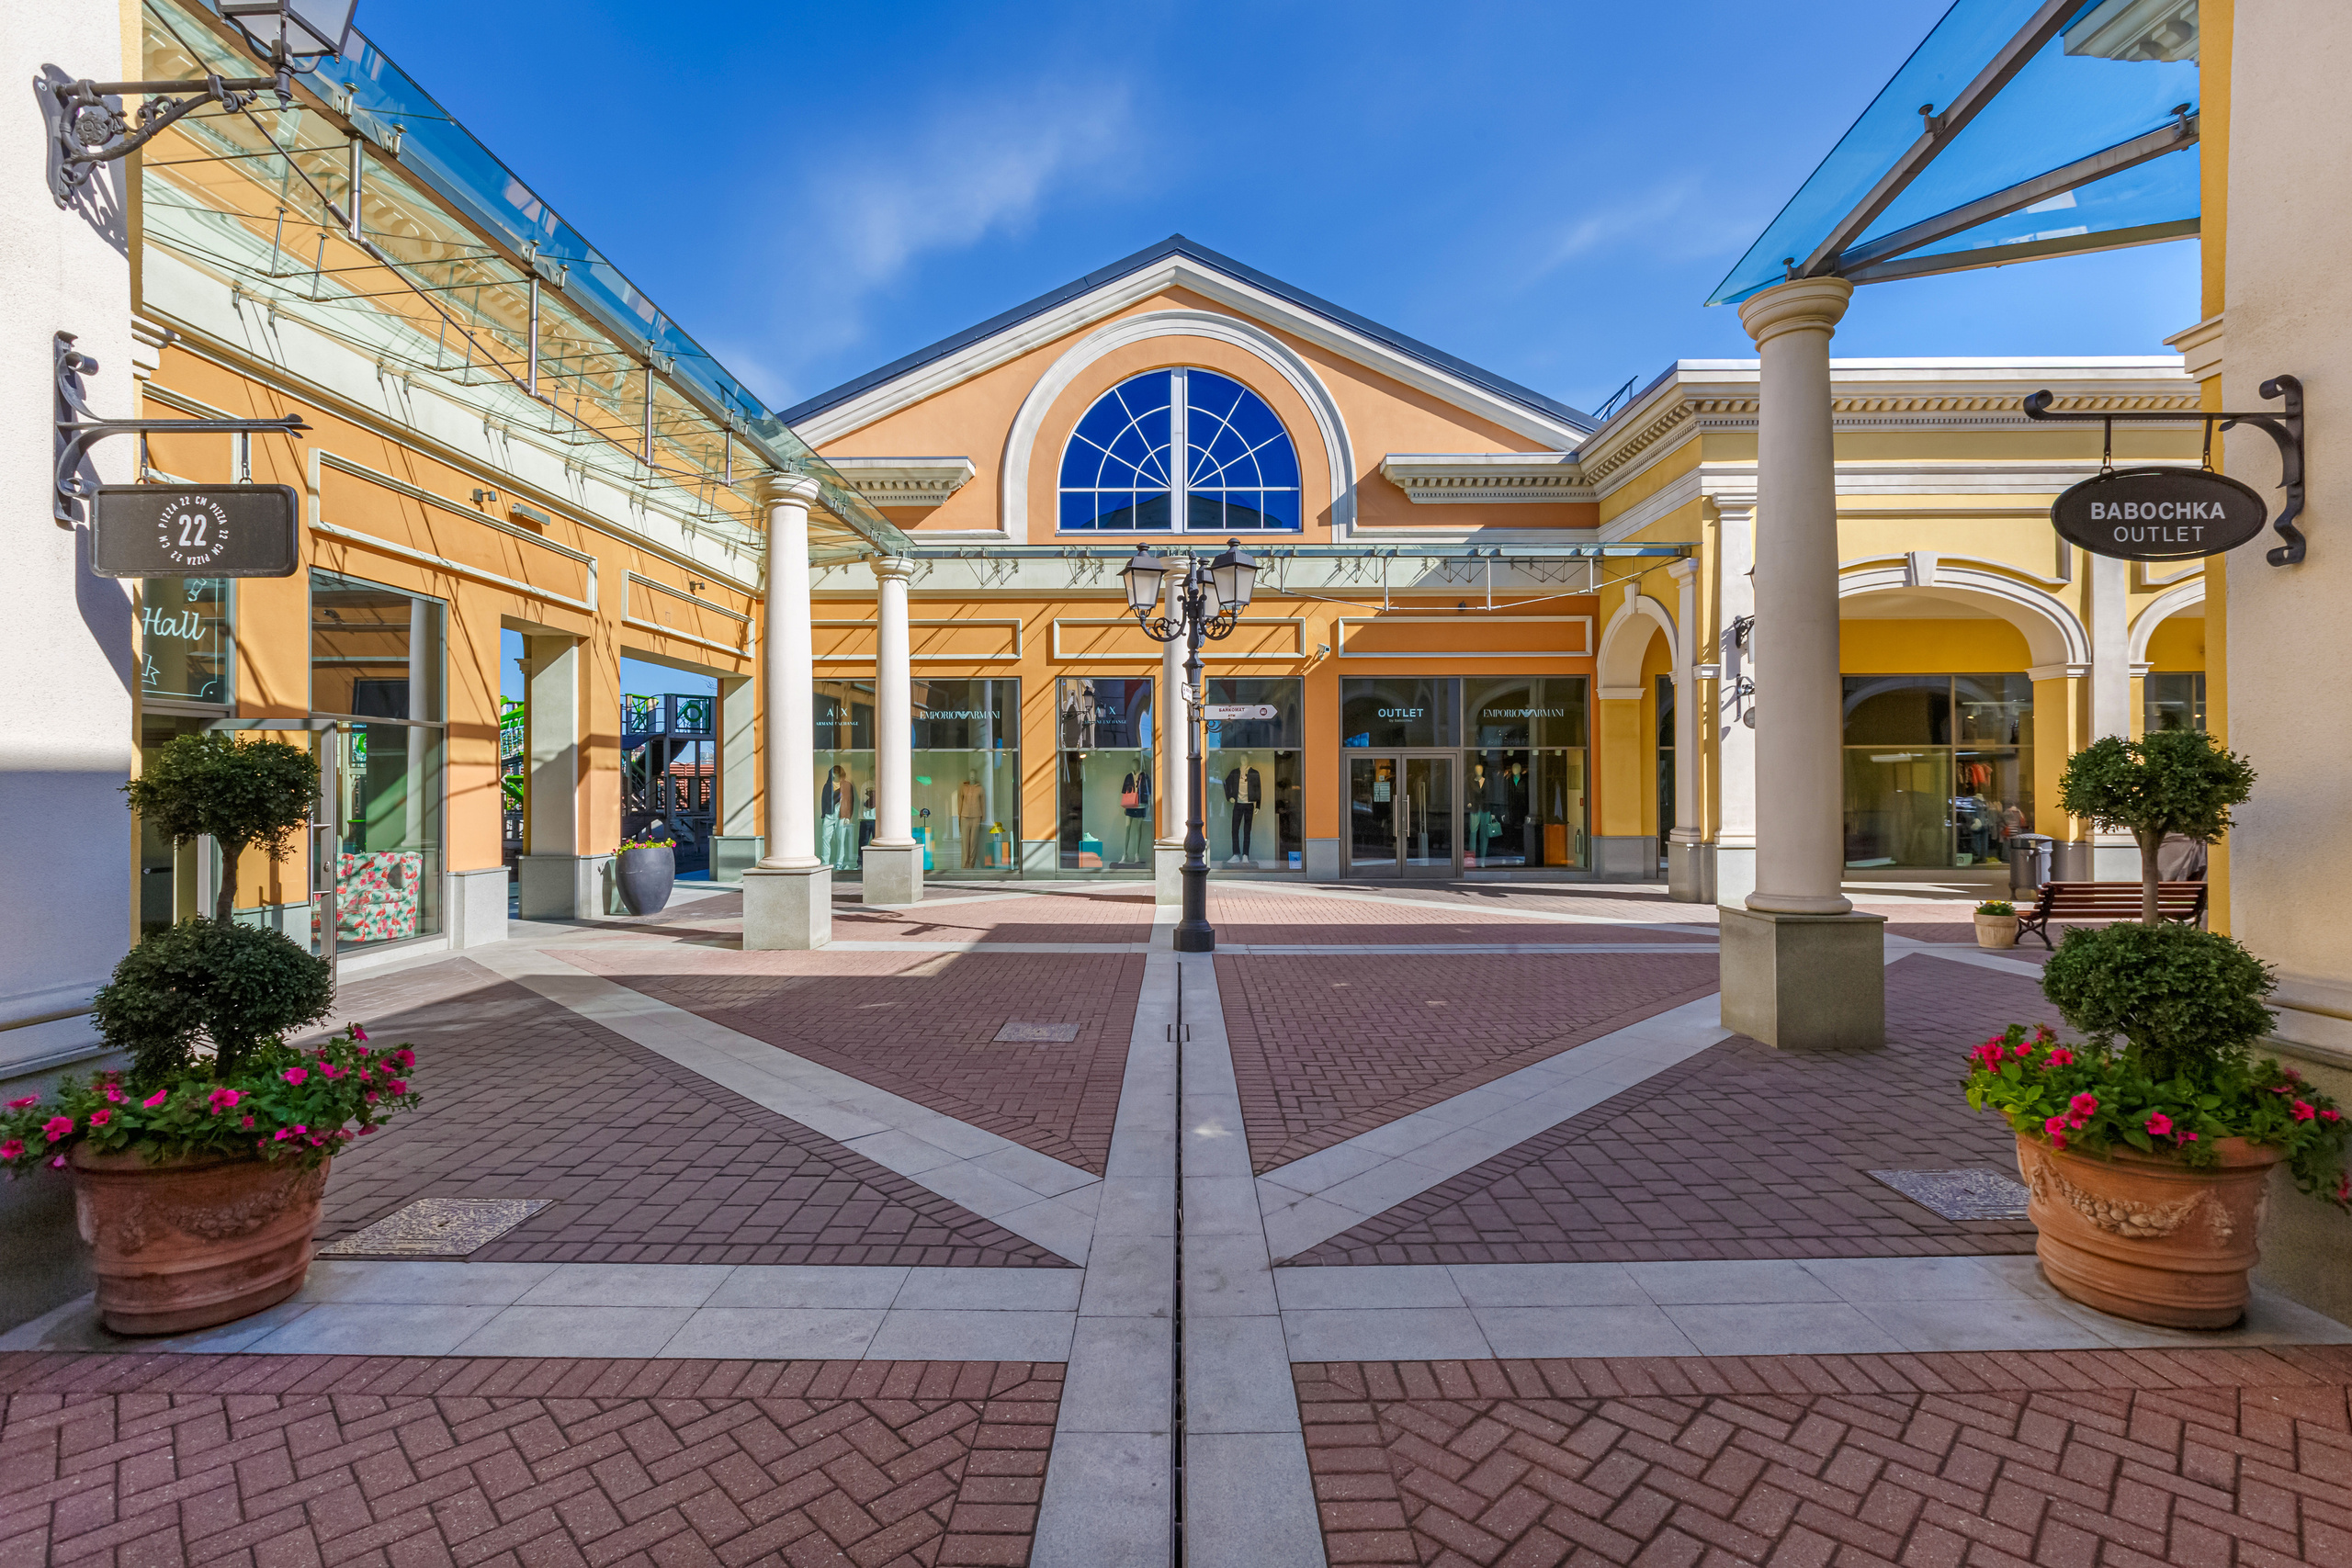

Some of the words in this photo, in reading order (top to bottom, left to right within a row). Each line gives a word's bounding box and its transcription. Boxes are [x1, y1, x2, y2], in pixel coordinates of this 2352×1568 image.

[179, 496, 191, 506] 22
[195, 495, 208, 506] CM
[158, 502, 179, 529] PIZZA
[209, 502, 228, 525] PIZZA
[2090, 502, 2226, 520] BABOCHKA
[178, 513, 207, 547] 22
[219, 529, 229, 540] 22
[2113, 526, 2204, 542] OUTLET
[158, 535, 171, 548] CM
[170, 550, 183, 562] 22
[210, 543, 224, 556] CM
[187, 553, 211, 566] PIZZA
[141, 607, 206, 641] Hall
[920, 710, 957, 720] EMPORIO
[967, 710, 1001, 720] ARMANI
[1378, 708, 1424, 717] OUTLET
[1483, 708, 1521, 717] EMPORIO
[1528, 708, 1564, 717] ARMANI
